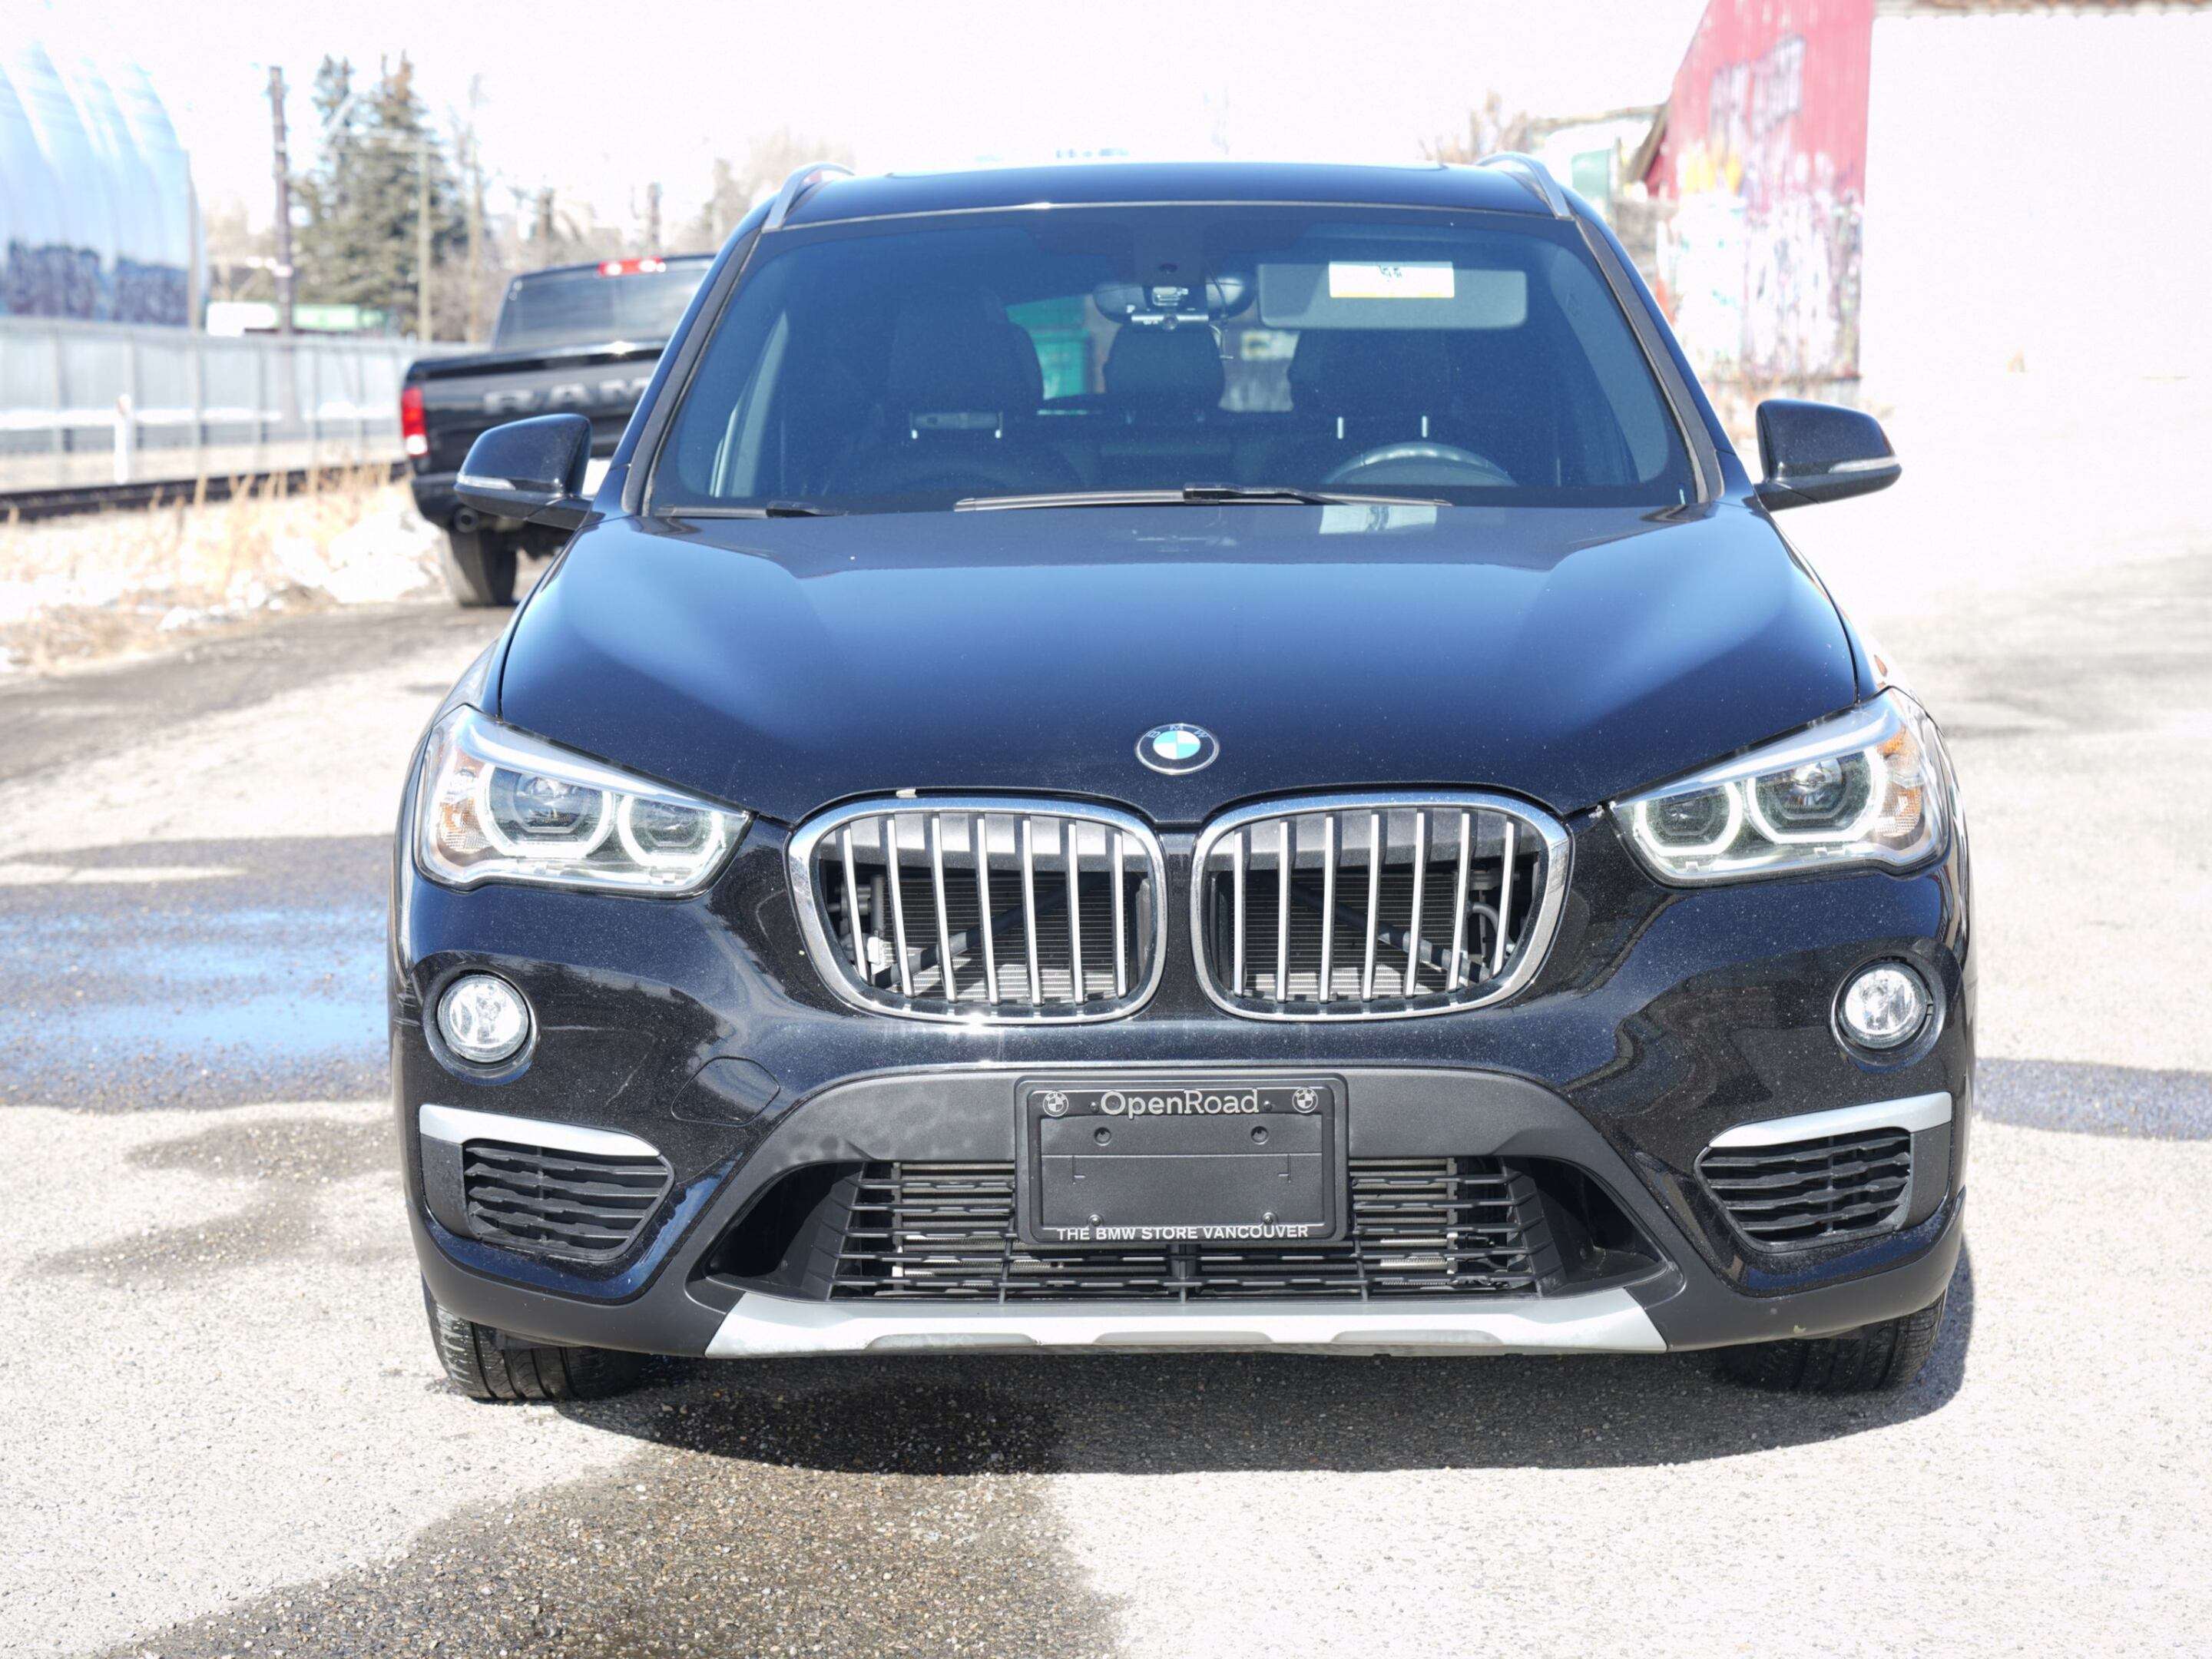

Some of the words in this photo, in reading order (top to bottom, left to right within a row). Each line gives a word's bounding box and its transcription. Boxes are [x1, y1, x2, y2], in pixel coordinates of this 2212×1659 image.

[484, 377, 651, 415] RAM
[1100, 1089, 1260, 1120] OpenRoad
[1057, 1228, 1091, 1241] THE
[1095, 1227, 1136, 1240] BMW
[1141, 1227, 1198, 1240] STORE
[1203, 1224, 1309, 1239] VANCOUVER
